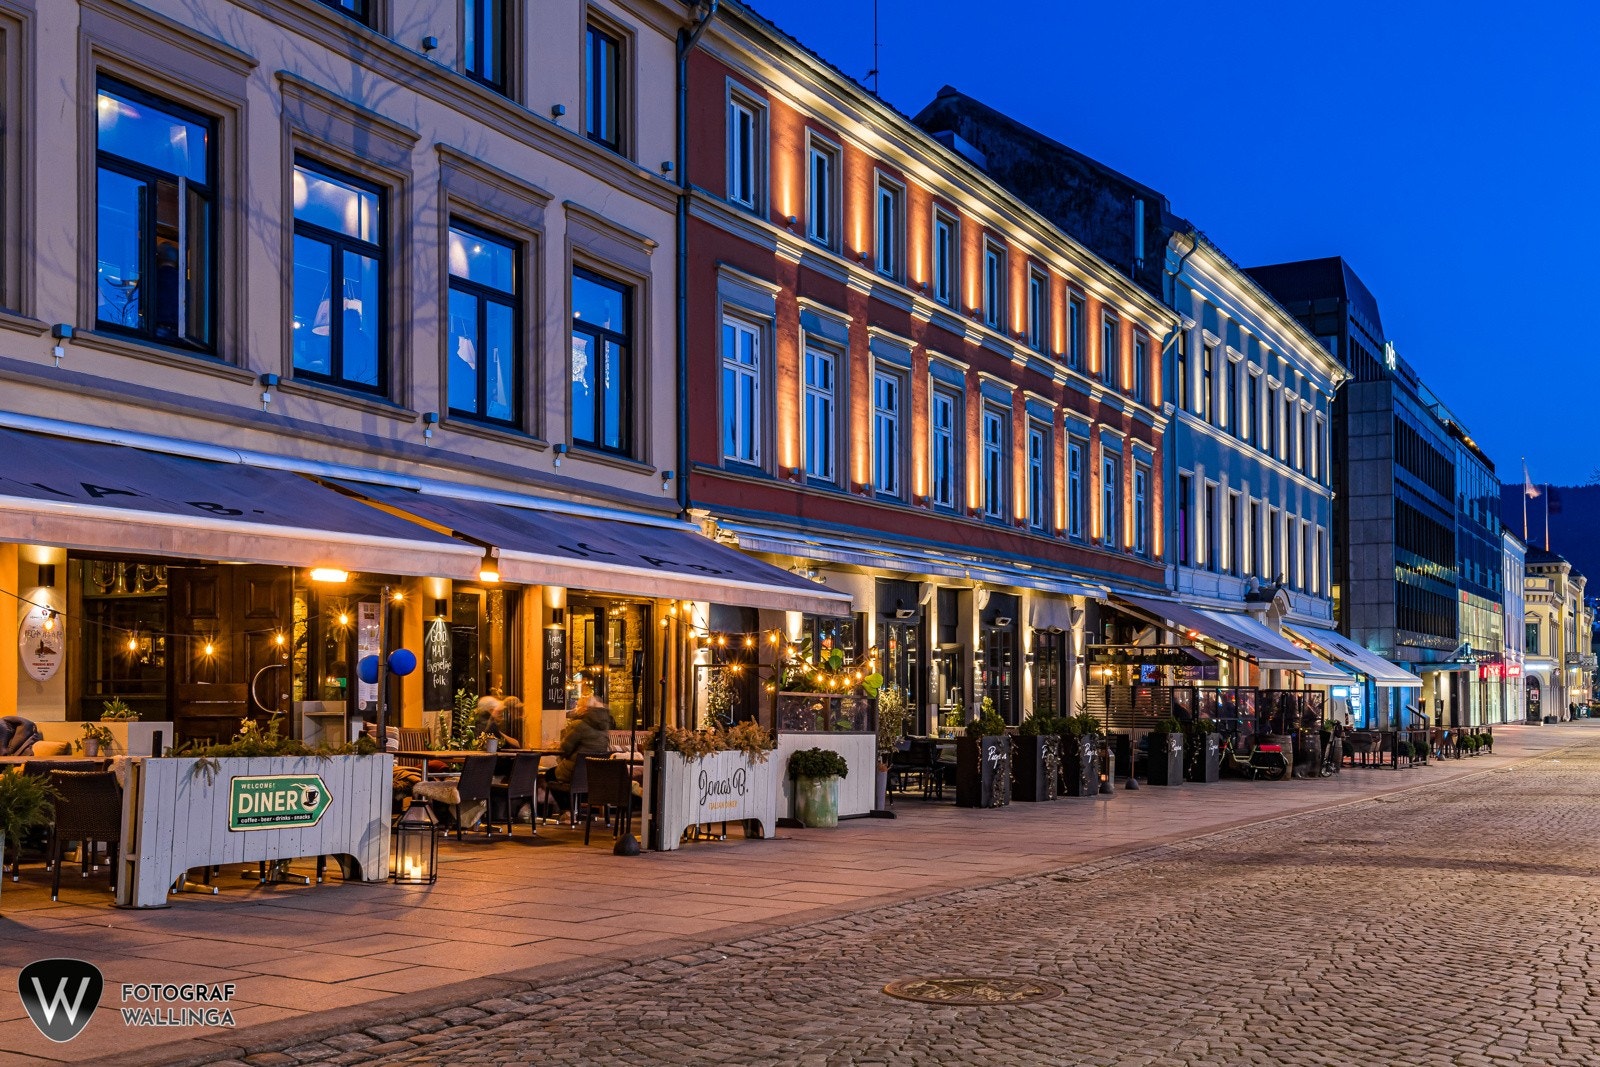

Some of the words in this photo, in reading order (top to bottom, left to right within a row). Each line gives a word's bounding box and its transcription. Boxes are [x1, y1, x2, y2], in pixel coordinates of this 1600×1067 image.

[432, 645, 446, 657] MAT
[699, 770, 731, 805] Jonas
[733, 768, 749, 796] B.
[238, 790, 298, 814] DINER
